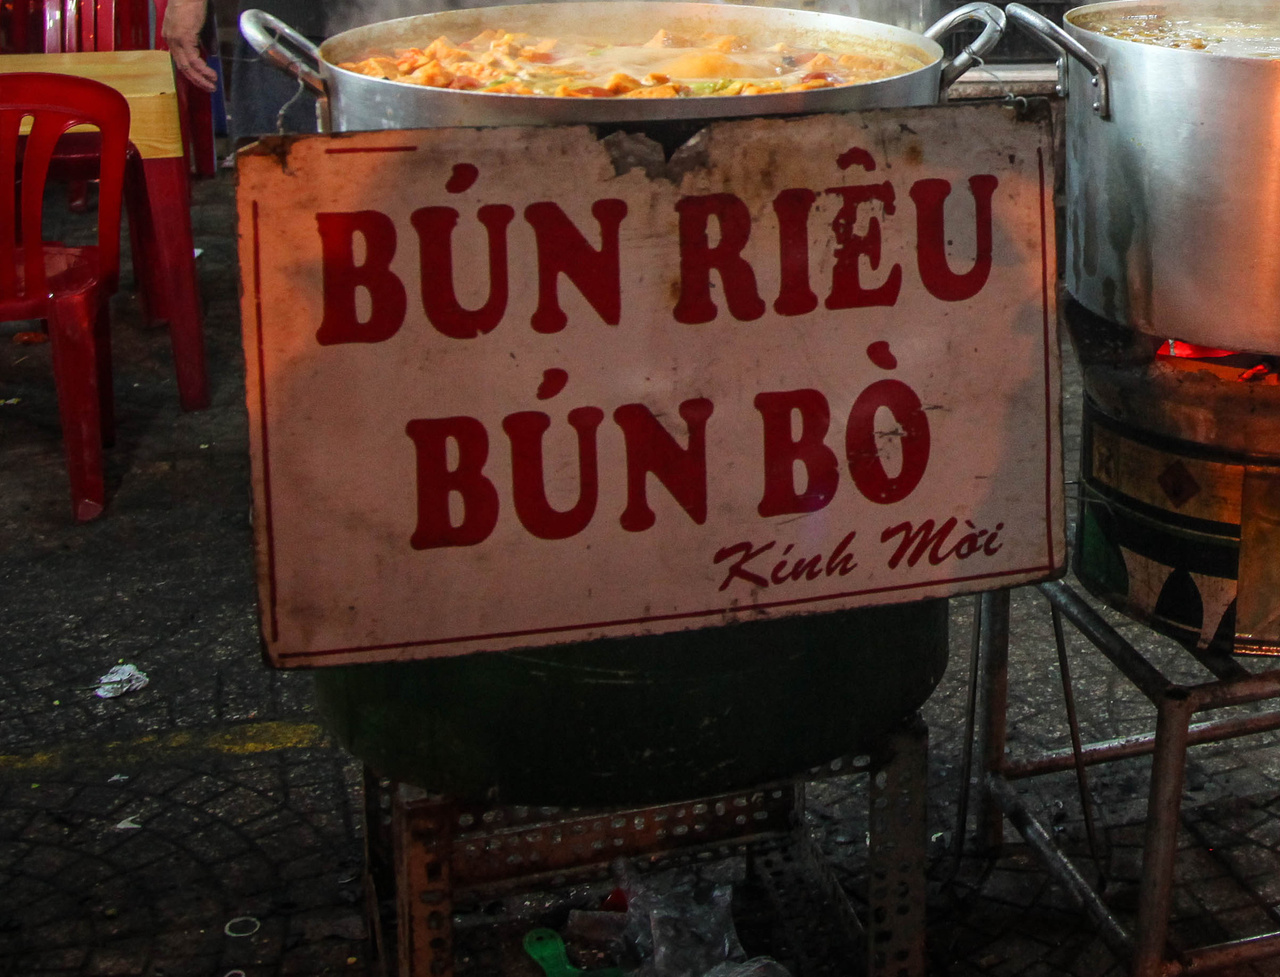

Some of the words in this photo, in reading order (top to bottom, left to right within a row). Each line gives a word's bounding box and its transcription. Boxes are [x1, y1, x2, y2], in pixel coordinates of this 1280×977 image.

[315, 162, 629, 346] BÚN
[672, 147, 999, 325] RIÊU
[405, 368, 715, 550] BÚN
[753, 340, 931, 519] BÒ
[712, 532, 858, 592] Kính
[880, 517, 1006, 571] Mời
